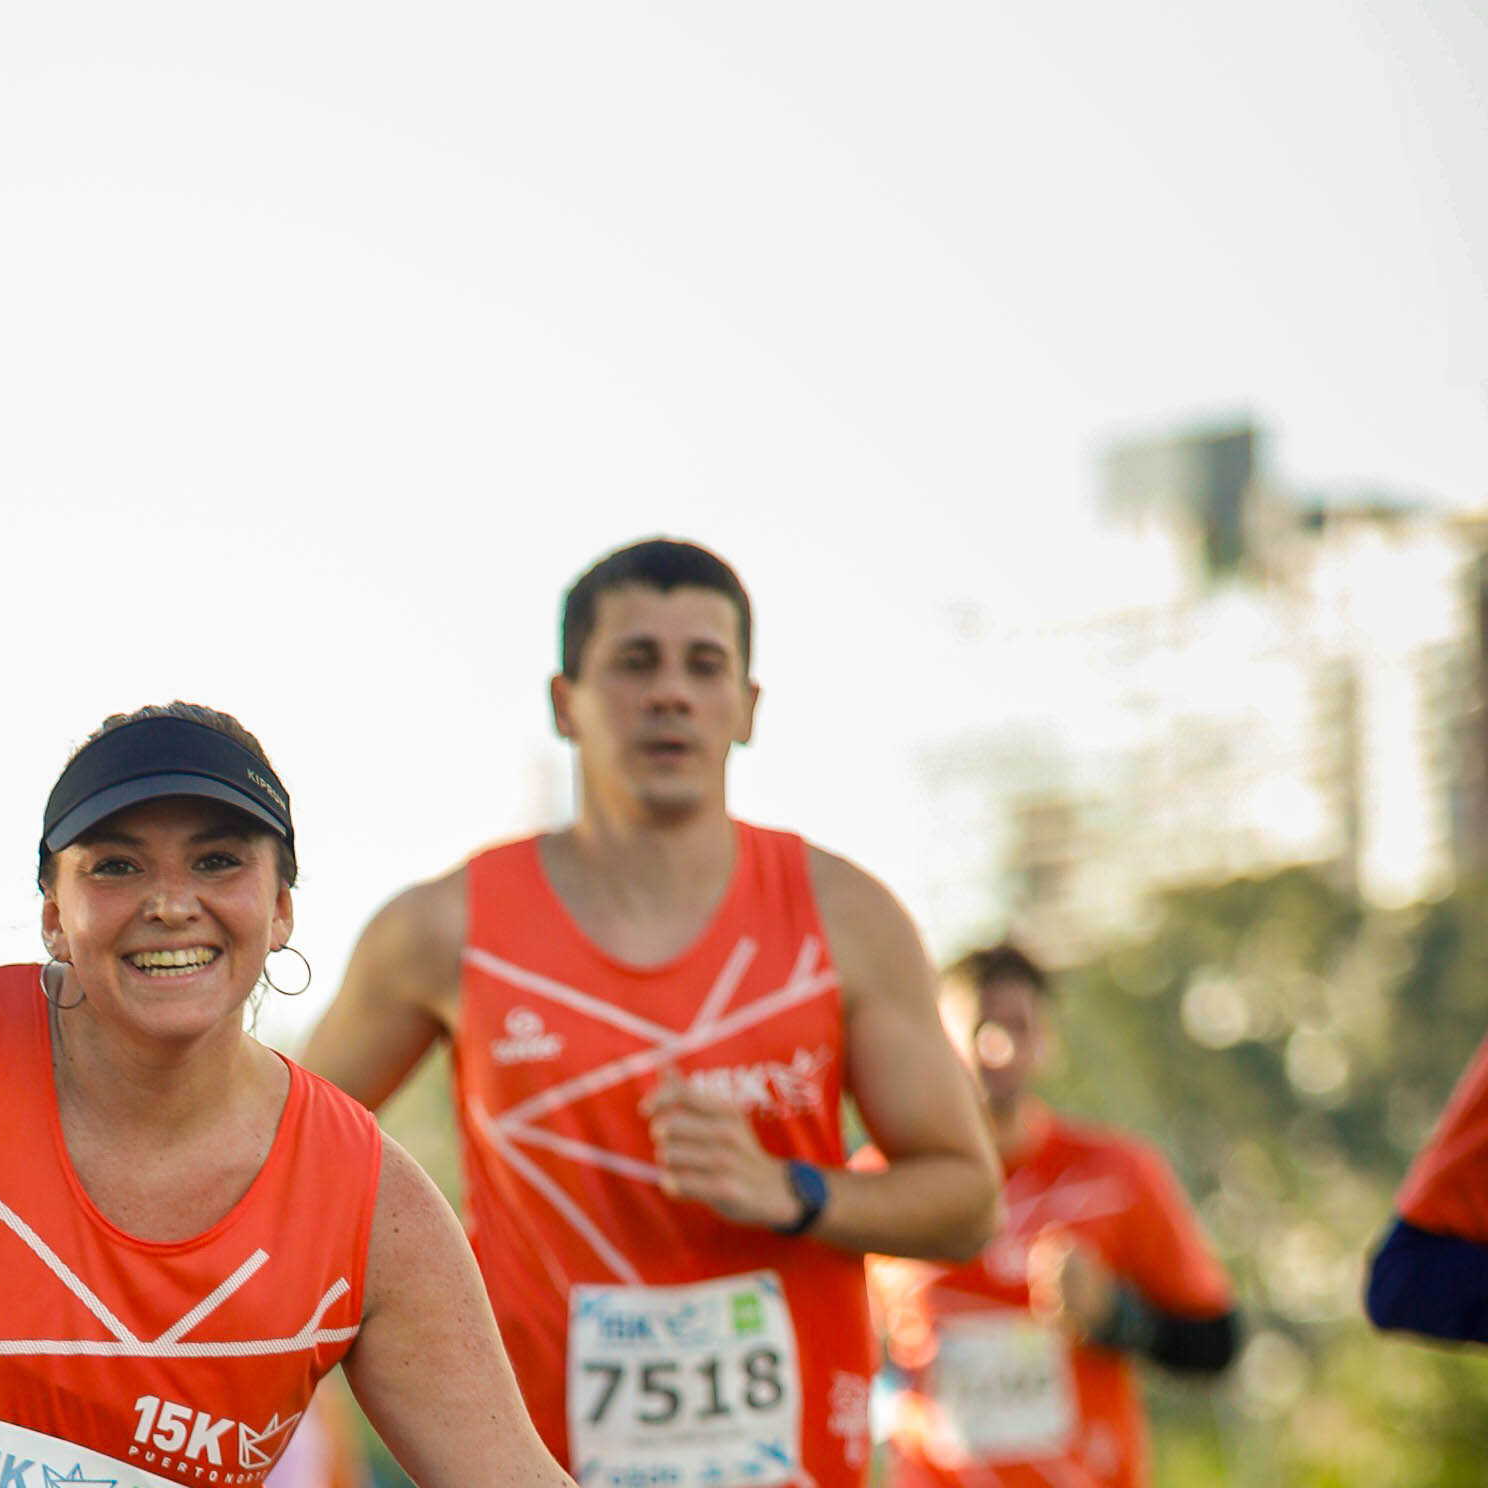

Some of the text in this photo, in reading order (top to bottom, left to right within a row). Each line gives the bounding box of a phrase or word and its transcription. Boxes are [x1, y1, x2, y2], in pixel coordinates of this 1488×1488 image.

[582, 1345, 783, 1426] 7518
[128, 1445, 219, 1482] PUERTO
[133, 1394, 236, 1466] 15K
